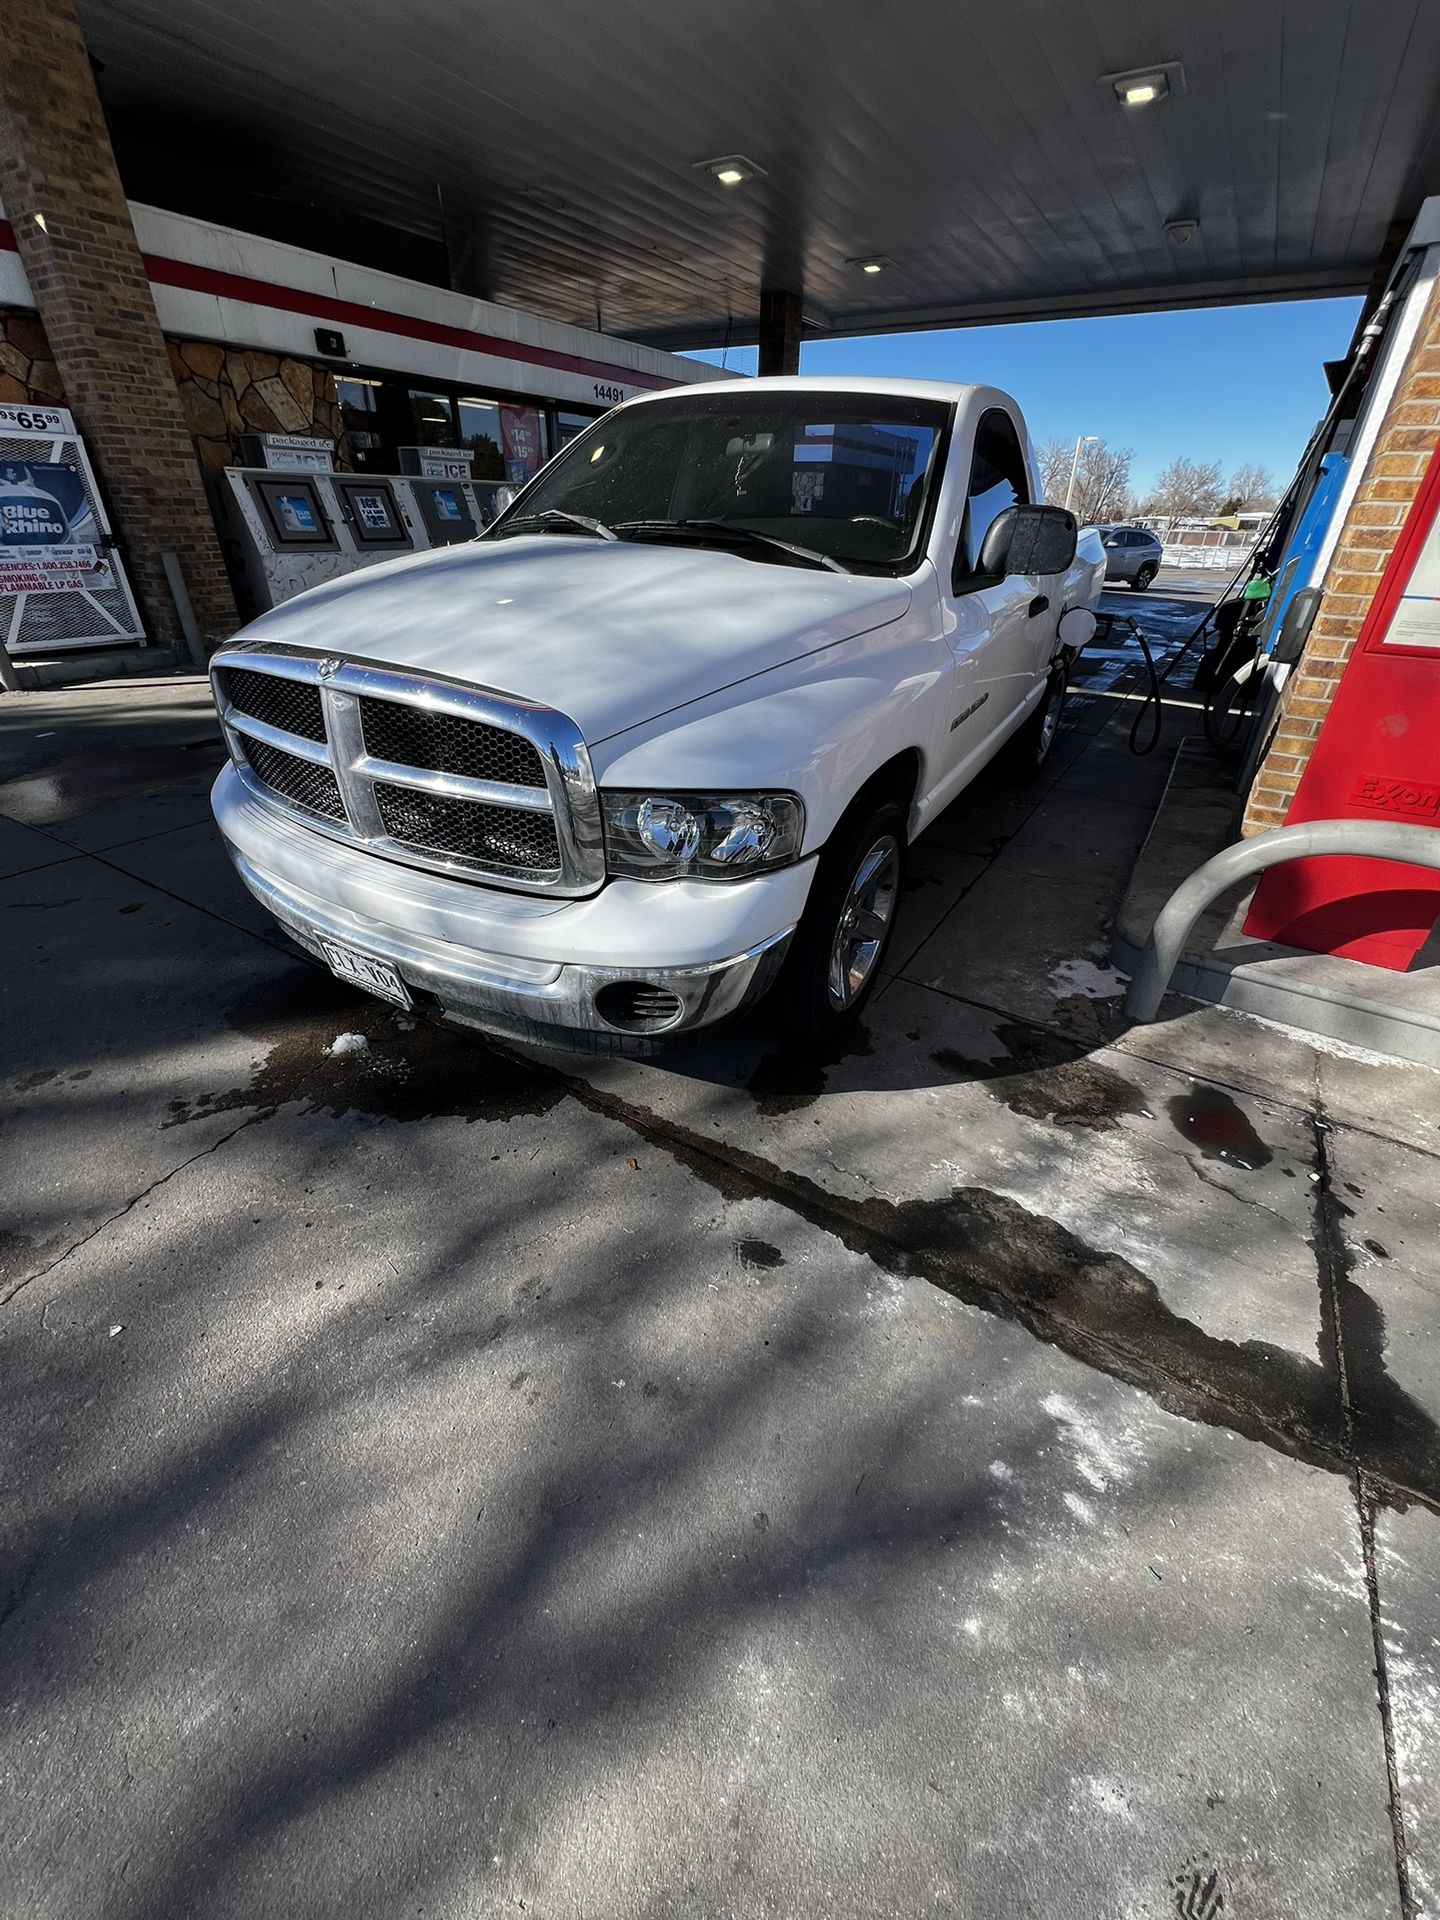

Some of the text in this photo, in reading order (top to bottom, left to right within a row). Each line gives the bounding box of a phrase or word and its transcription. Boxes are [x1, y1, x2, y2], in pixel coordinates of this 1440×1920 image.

[593, 383, 624, 402] 14491
[272, 436, 332, 448] packaged ice
[444, 464, 466, 479] ICE
[3, 505, 50, 518] Blue
[6, 519, 63, 534] Rhino
[0, 563, 36, 571] GENCIES:
[55, 581, 65, 589] LP
[67, 579, 84, 588] GAS
[326, 947, 402, 994] CLX-V04
